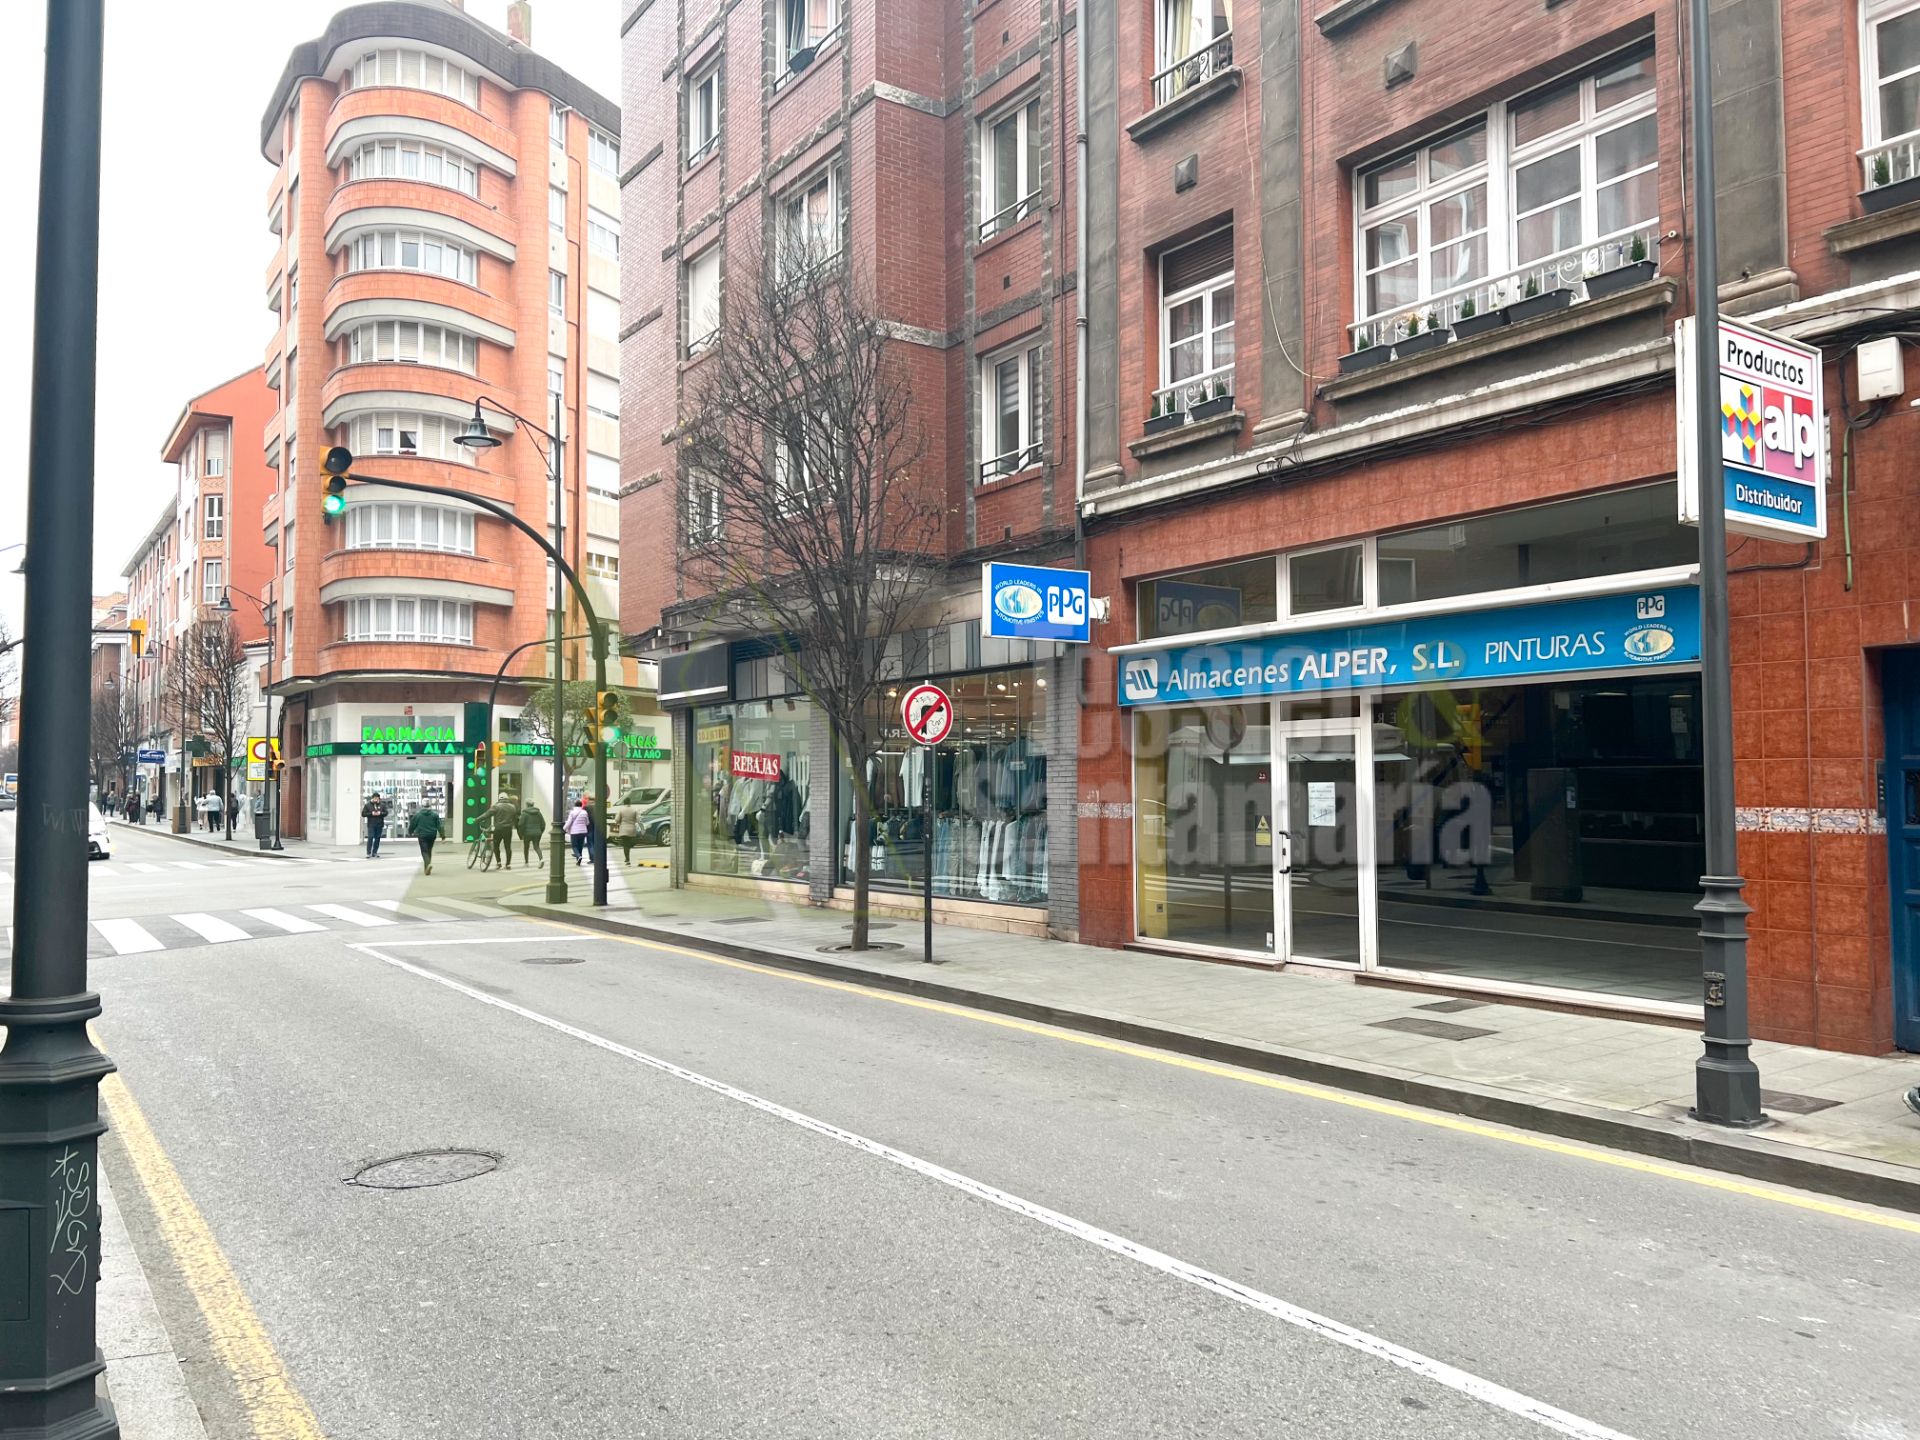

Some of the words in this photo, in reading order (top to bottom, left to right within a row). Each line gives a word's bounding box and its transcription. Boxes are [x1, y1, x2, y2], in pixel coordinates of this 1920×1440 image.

[1727, 339, 1804, 386] Productos
[1763, 394, 1816, 470] alp
[1735, 483, 1803, 514] Distribuidor
[994, 579, 1013, 590] WORLD
[1014, 579, 1036, 590] LEADERS
[1049, 588, 1083, 617] PPG
[1638, 597, 1663, 615] PPG
[994, 608, 1024, 625] AUTOMOTIVE
[1024, 610, 1045, 624] FINISHES
[1624, 624, 1643, 636] WORLD
[1644, 623, 1667, 631] LEADERS
[1165, 662, 1289, 692] Almacenes
[1298, 647, 1397, 681] ALPER,
[1412, 641, 1460, 672] S.L.
[1485, 631, 1606, 665] PINTURAS
[362, 726, 456, 741] FARMACIA
[360, 743, 384, 755] 365
[423, 743, 441, 755] AL
[541, 745, 551, 755] 12
[733, 755, 778, 776] REBAJAS
